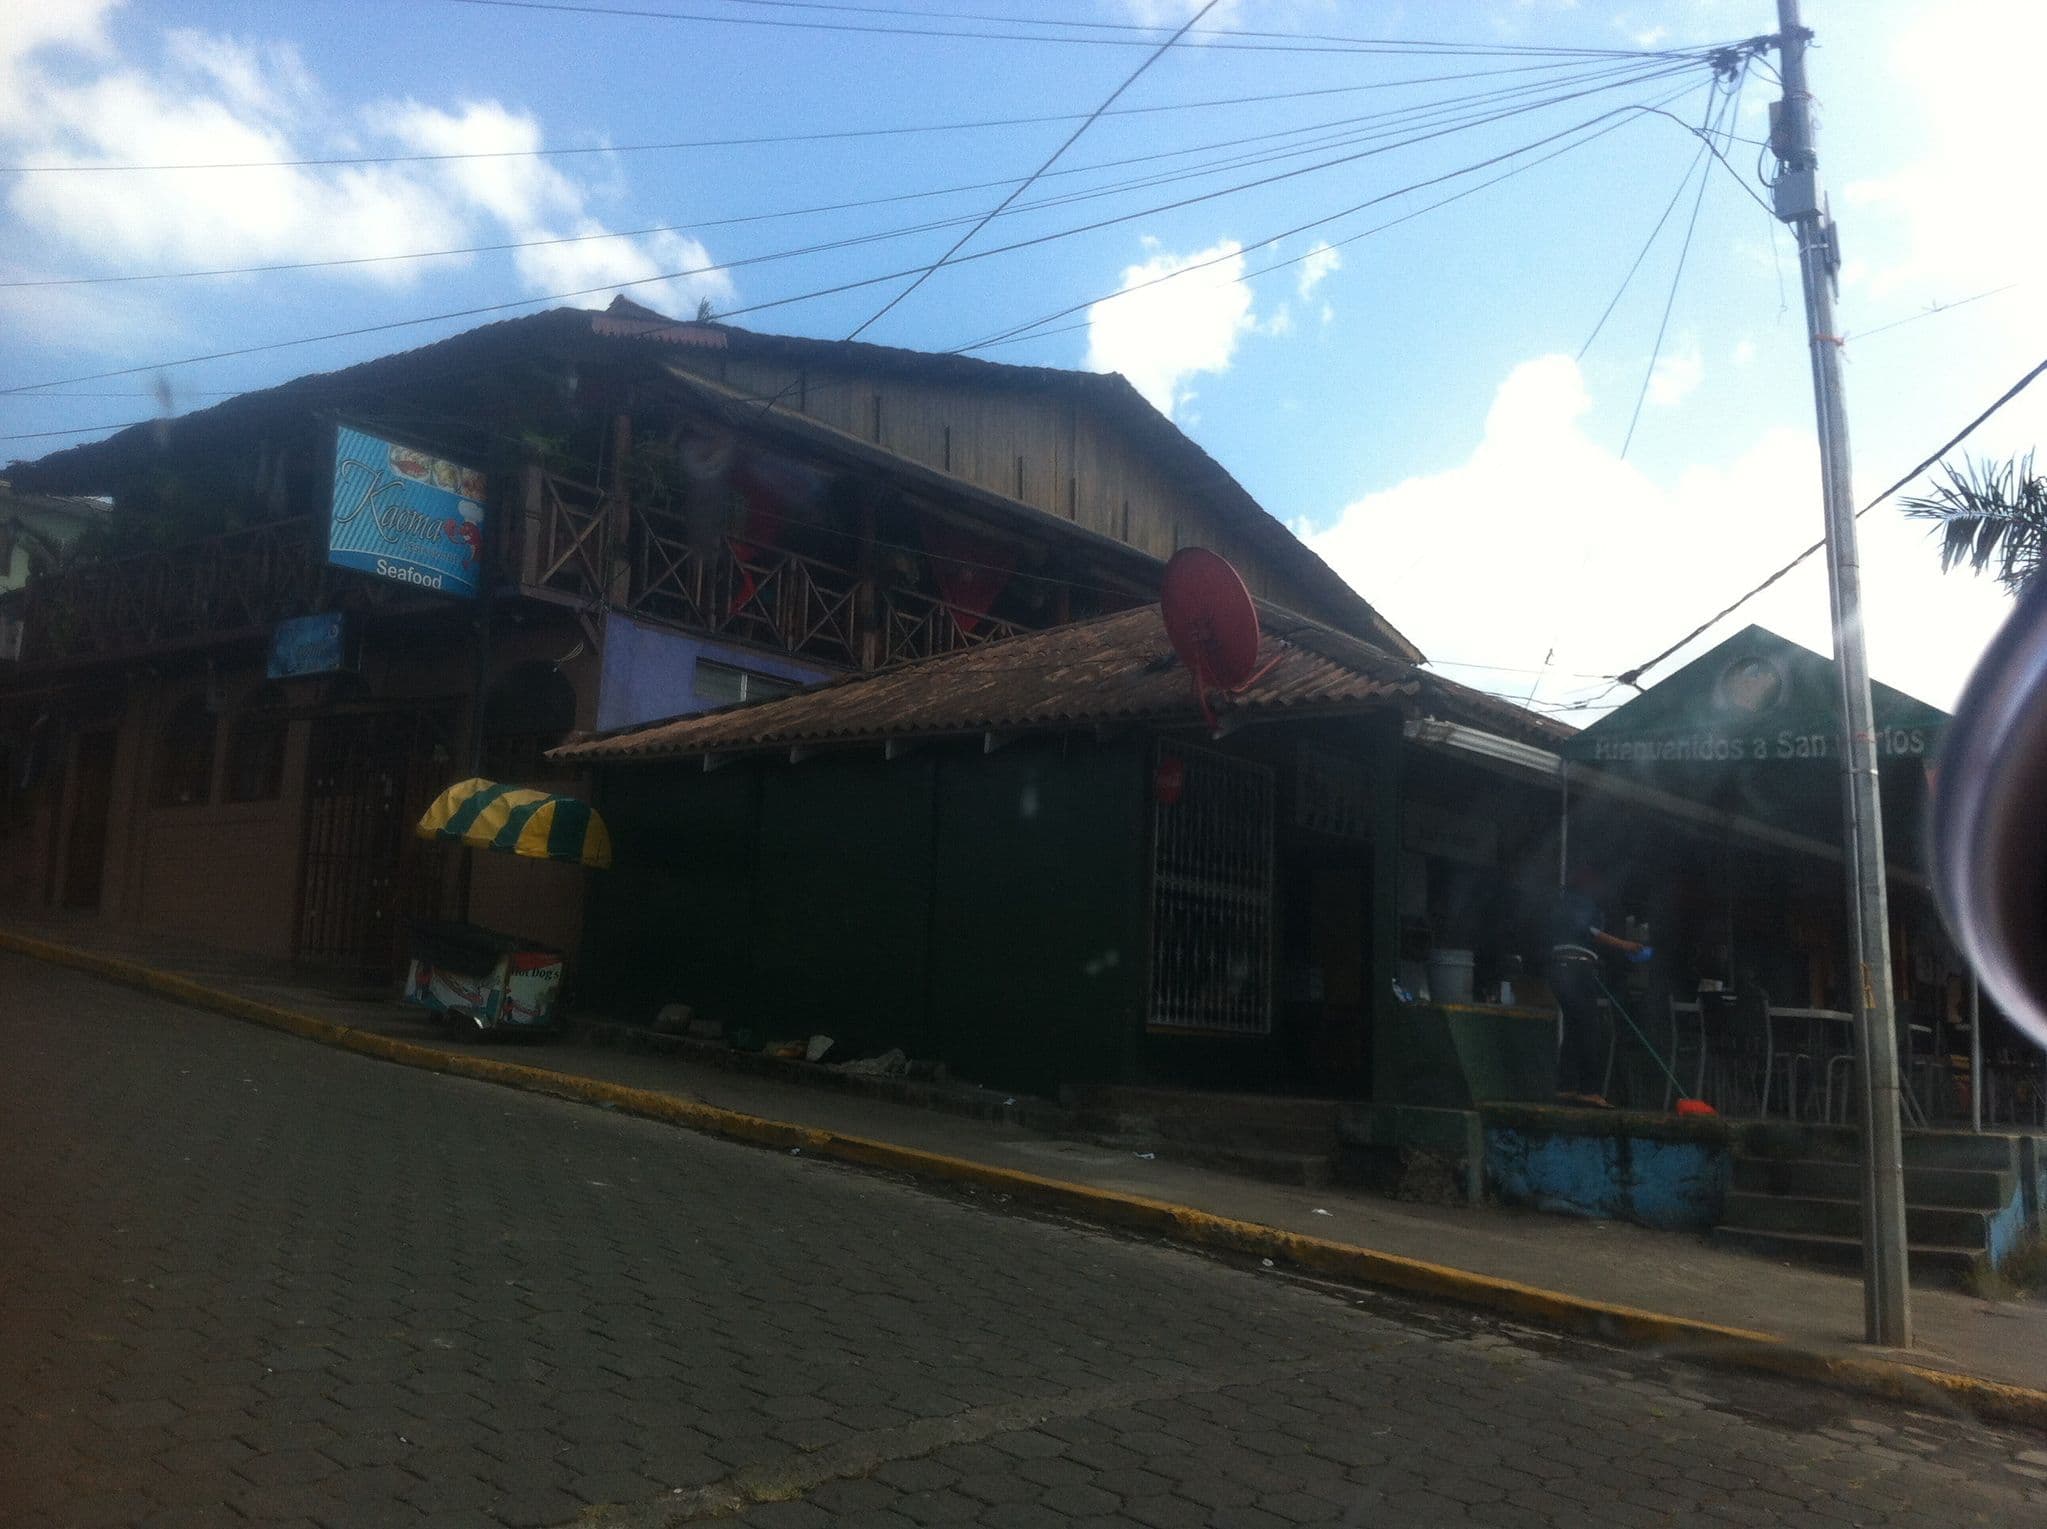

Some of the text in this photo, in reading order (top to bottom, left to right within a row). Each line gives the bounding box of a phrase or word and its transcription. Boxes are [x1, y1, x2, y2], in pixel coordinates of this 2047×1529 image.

[337, 459, 444, 544] Kaoma
[376, 559, 443, 590] Seafood
[1753, 738, 1767, 760] a
[1776, 729, 1827, 759] San
